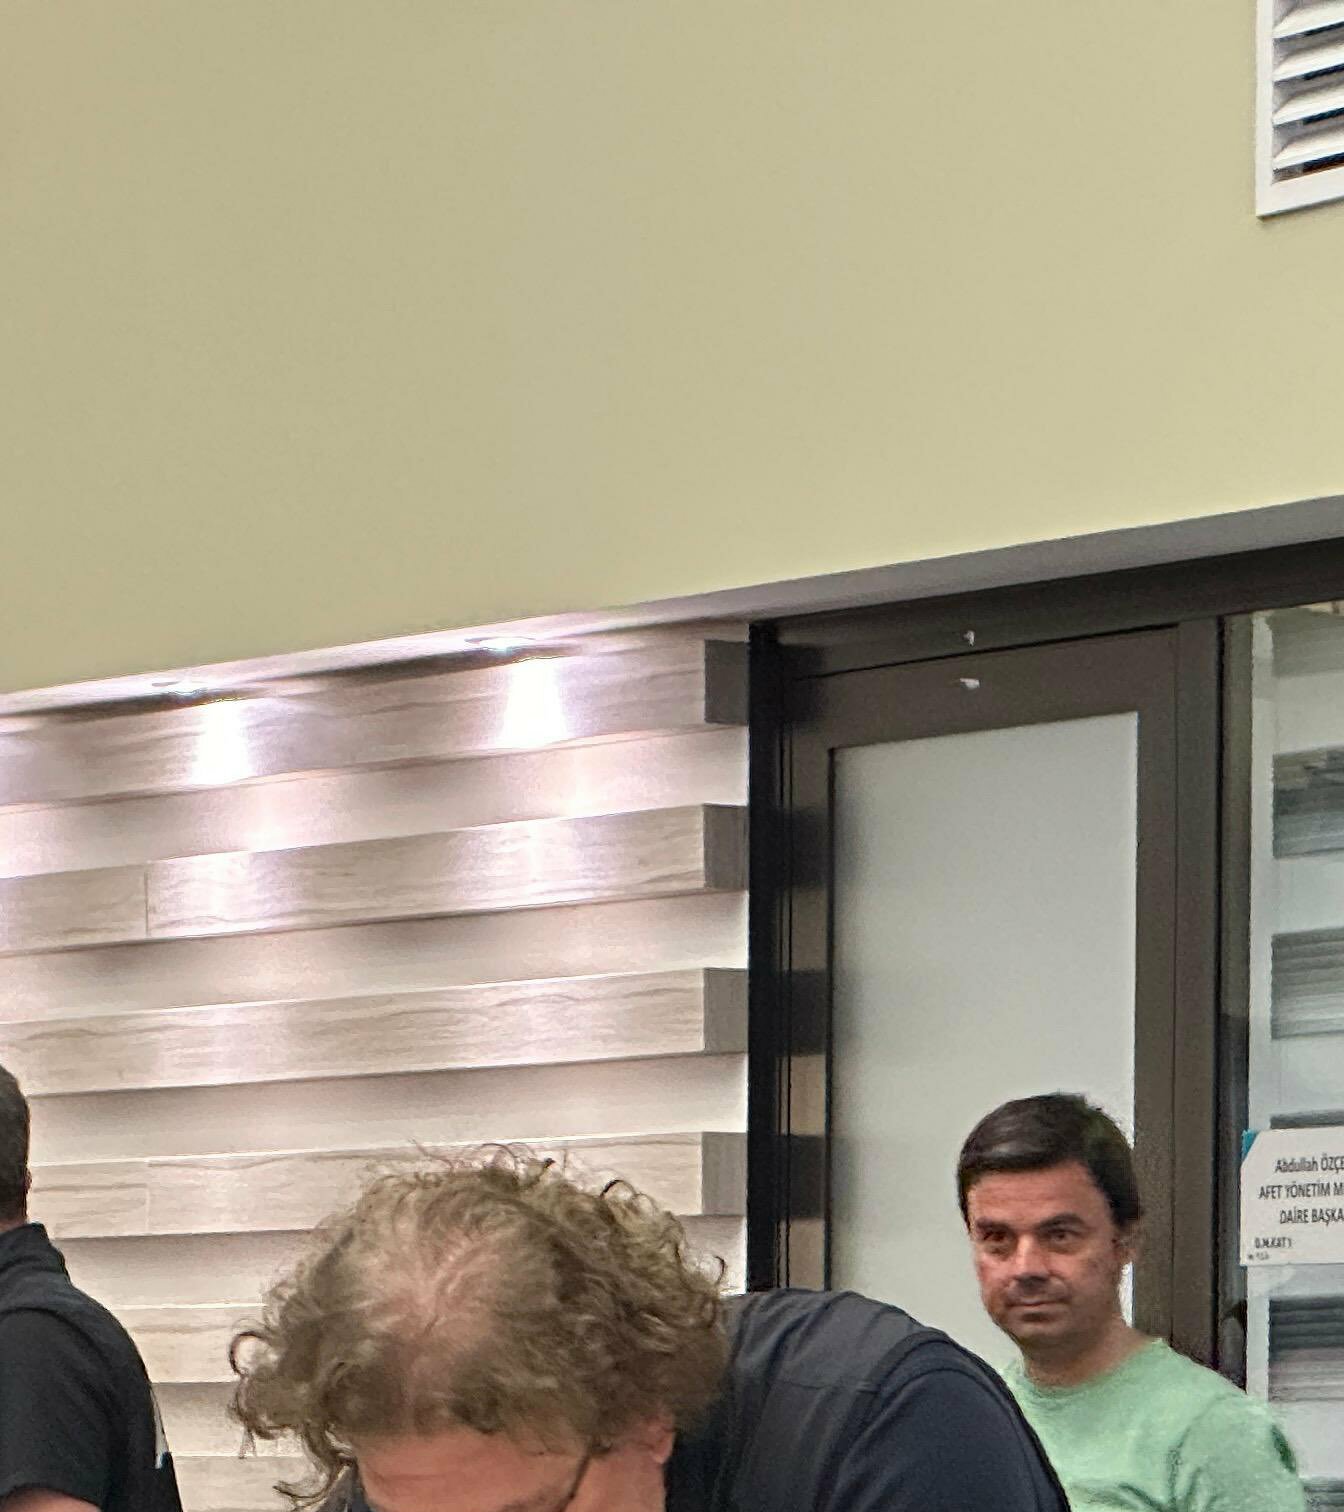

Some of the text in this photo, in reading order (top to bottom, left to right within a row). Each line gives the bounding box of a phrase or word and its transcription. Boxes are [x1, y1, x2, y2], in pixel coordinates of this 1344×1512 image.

[1274, 1156, 1318, 1174] Abdullah
[1258, 1184, 1286, 1200] AFET
[1285, 1179, 1331, 1199] YÖNETİM
